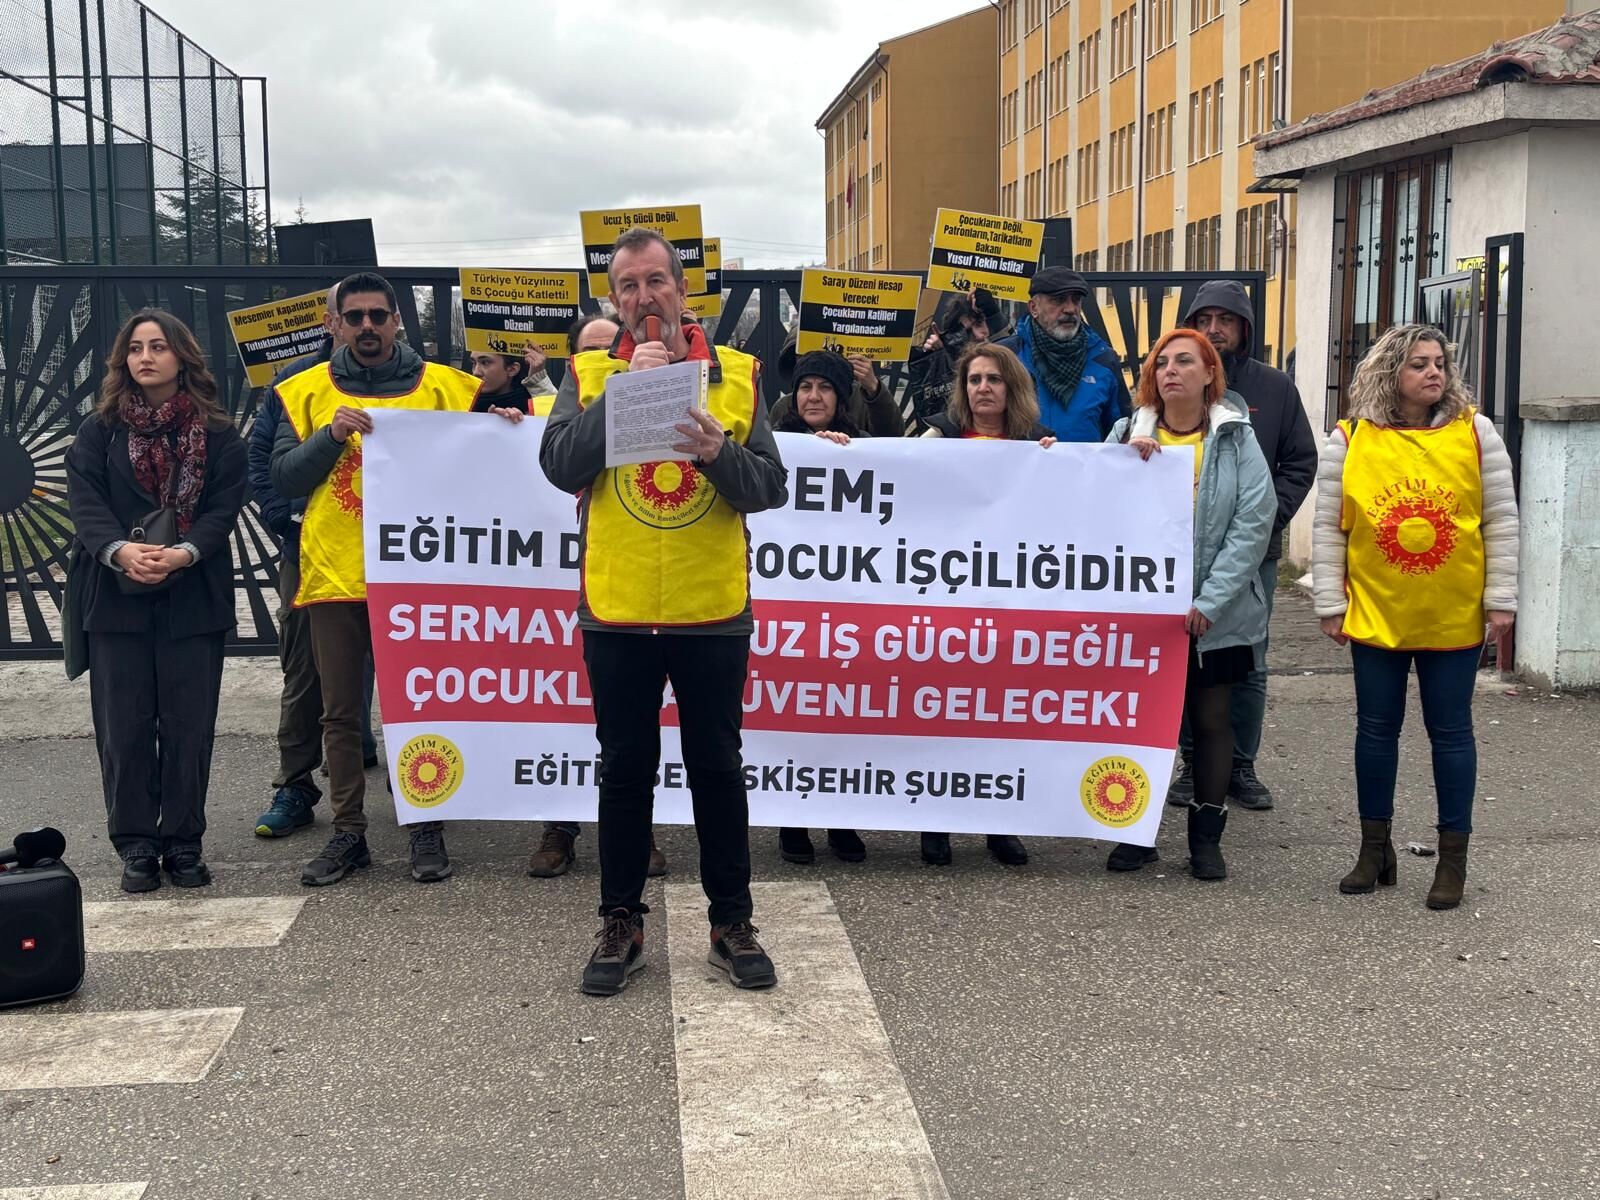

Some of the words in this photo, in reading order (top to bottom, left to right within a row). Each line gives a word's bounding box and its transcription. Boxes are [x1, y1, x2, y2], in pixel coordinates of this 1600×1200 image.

[603, 215, 622, 226] Ucuz
[623, 213, 632, 227] İş
[633, 212, 653, 224] Gücü
[655, 211, 679, 223] Değil,
[959, 214, 1001, 230] Çocukların
[1002, 217, 1024, 234] Değil,
[975, 241, 1002, 255] Bakanı
[947, 251, 972, 265] Yusuf
[974, 255, 998, 270] Tekin
[998, 257, 1024, 274] İstifa!
[473, 273, 511, 287] Türkiye
[514, 275, 565, 288] Yüzyılınız
[822, 275, 847, 289] Saray
[848, 277, 876, 289] Düzeni
[877, 280, 903, 293] Hesap
[470, 286, 482, 296] 85
[484, 287, 524, 300] Çocuğu
[527, 289, 569, 300] Katletti!
[842, 292, 880, 305] Verecek!
[233, 309, 275, 327] Mesemler
[276, 299, 317, 316] Kapatılsın
[467, 302, 510, 315] Çocukların
[512, 304, 534, 316] Katili
[535, 305, 573, 318] Sermaye
[822, 305, 866, 319] Çocukların
[867, 309, 898, 322] Katilleri
[267, 321, 284, 333] Suç
[284, 311, 318, 329] Değildir!
[504, 318, 534, 332] Düzeni!
[832, 321, 886, 336] Yargılanacak!
[244, 334, 291, 353] Tutuklanan
[265, 346, 298, 362] Serbest
[795, 466, 894, 526] EM;
[1366, 475, 1428, 519] EĞİTİM
[379, 515, 544, 568] EĞİTİM
[750, 541, 882, 584] OCUK
[895, 537, 1176, 595] İŞÇİLİĞİDİR!
[388, 603, 580, 646] SERMAY
[819, 612, 860, 669] İŞ
[874, 615, 998, 665] GÜCÜ
[1011, 623, 1161, 676] DEĞİL;
[741, 670, 899, 719] ÜVENLİ
[913, 686, 1139, 728] GELECEK!
[514, 752, 602, 787] EĞİTİ
[742, 759, 897, 801] SKİŞEHİR
[904, 767, 1025, 804] ŞUBESİ
